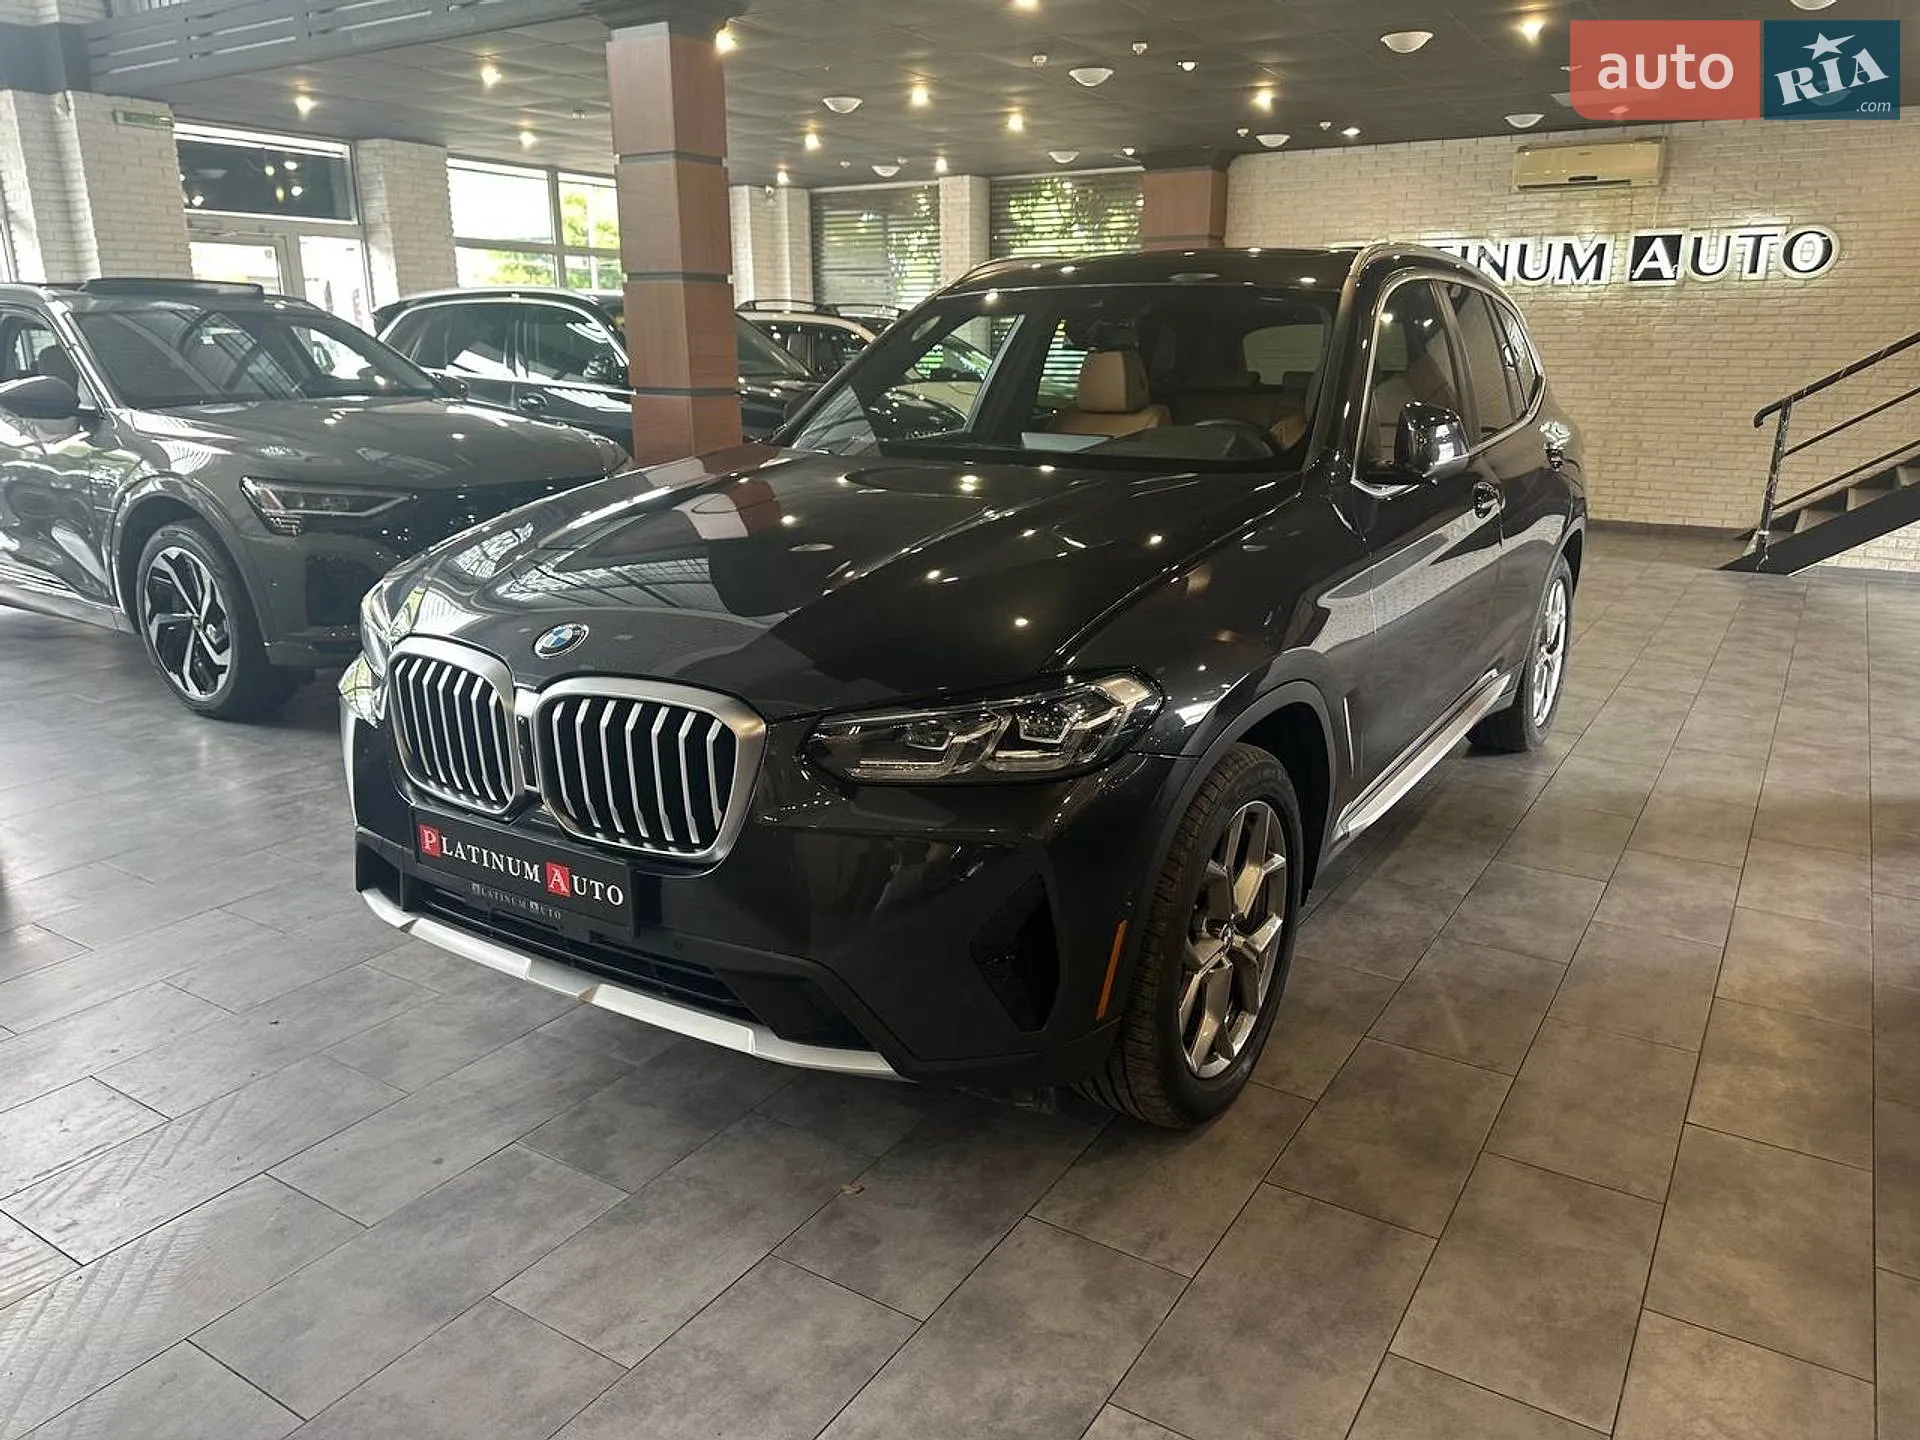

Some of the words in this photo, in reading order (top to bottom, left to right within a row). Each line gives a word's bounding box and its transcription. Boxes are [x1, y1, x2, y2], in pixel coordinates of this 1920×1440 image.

[1628, 231, 1833, 282] AUTO
[421, 827, 541, 884] PLATINUM
[547, 864, 624, 906] AUTO
